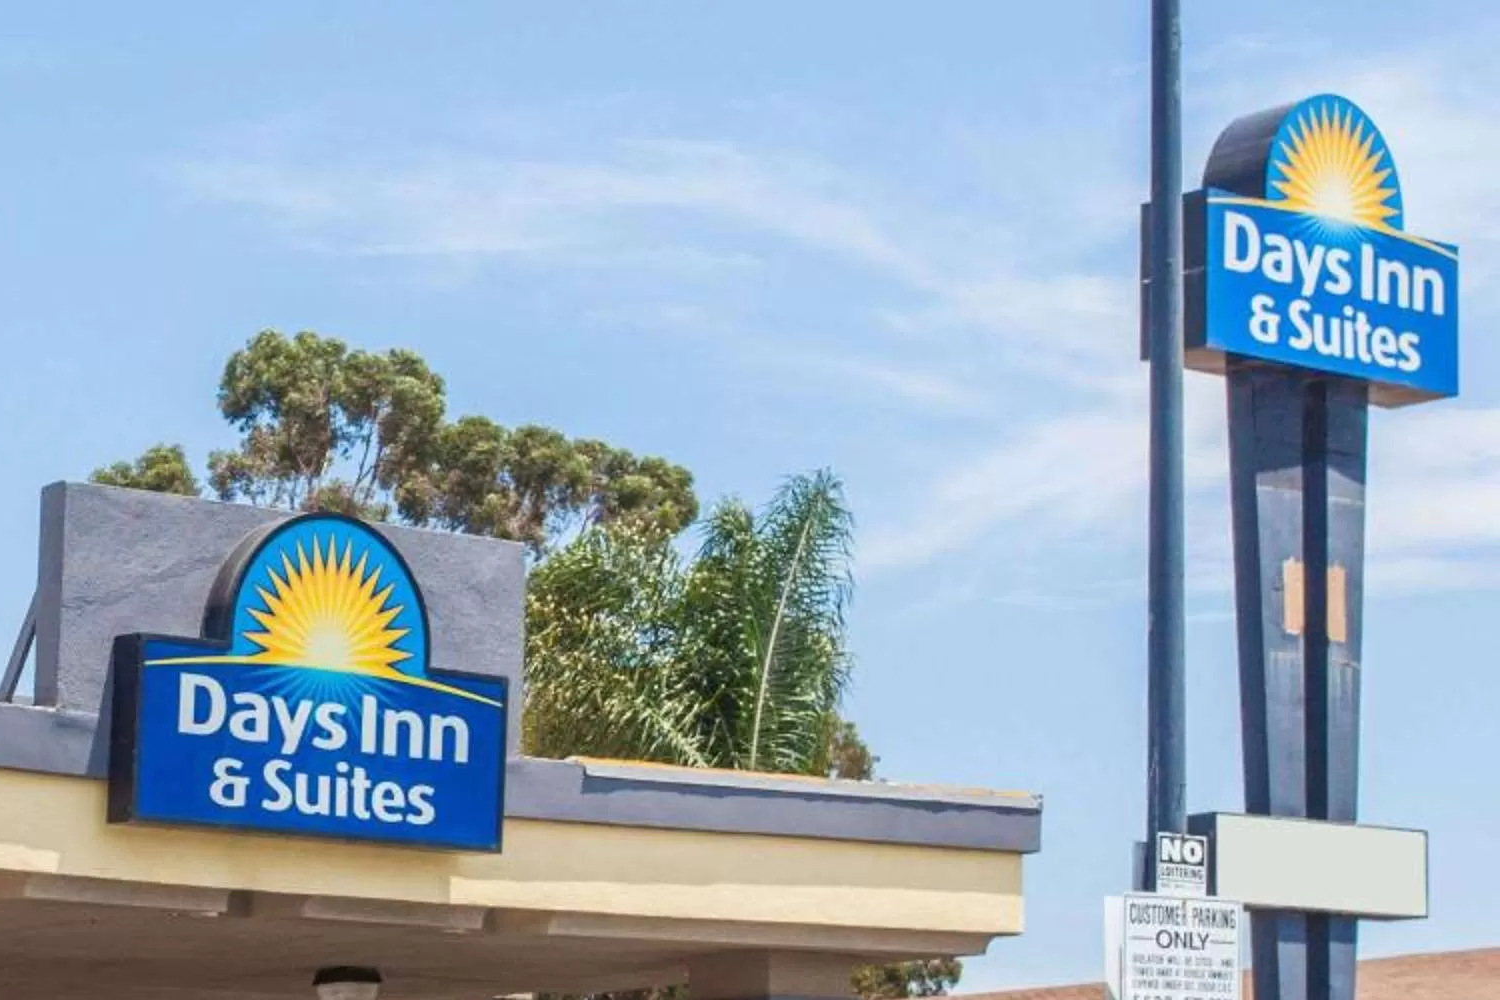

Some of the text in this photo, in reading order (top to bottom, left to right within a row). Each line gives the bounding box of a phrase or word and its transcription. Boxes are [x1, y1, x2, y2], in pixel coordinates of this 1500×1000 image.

[1223, 210, 1445, 316] Days Inn
[1249, 294, 1421, 372] & Suites
[178, 673, 469, 763] Days Inn
[209, 758, 435, 825] & Suites
[1161, 837, 1203, 864] NO
[1129, 903, 1237, 929] CUSTOMER PARKING
[1155, 929, 1209, 950] ONLY
